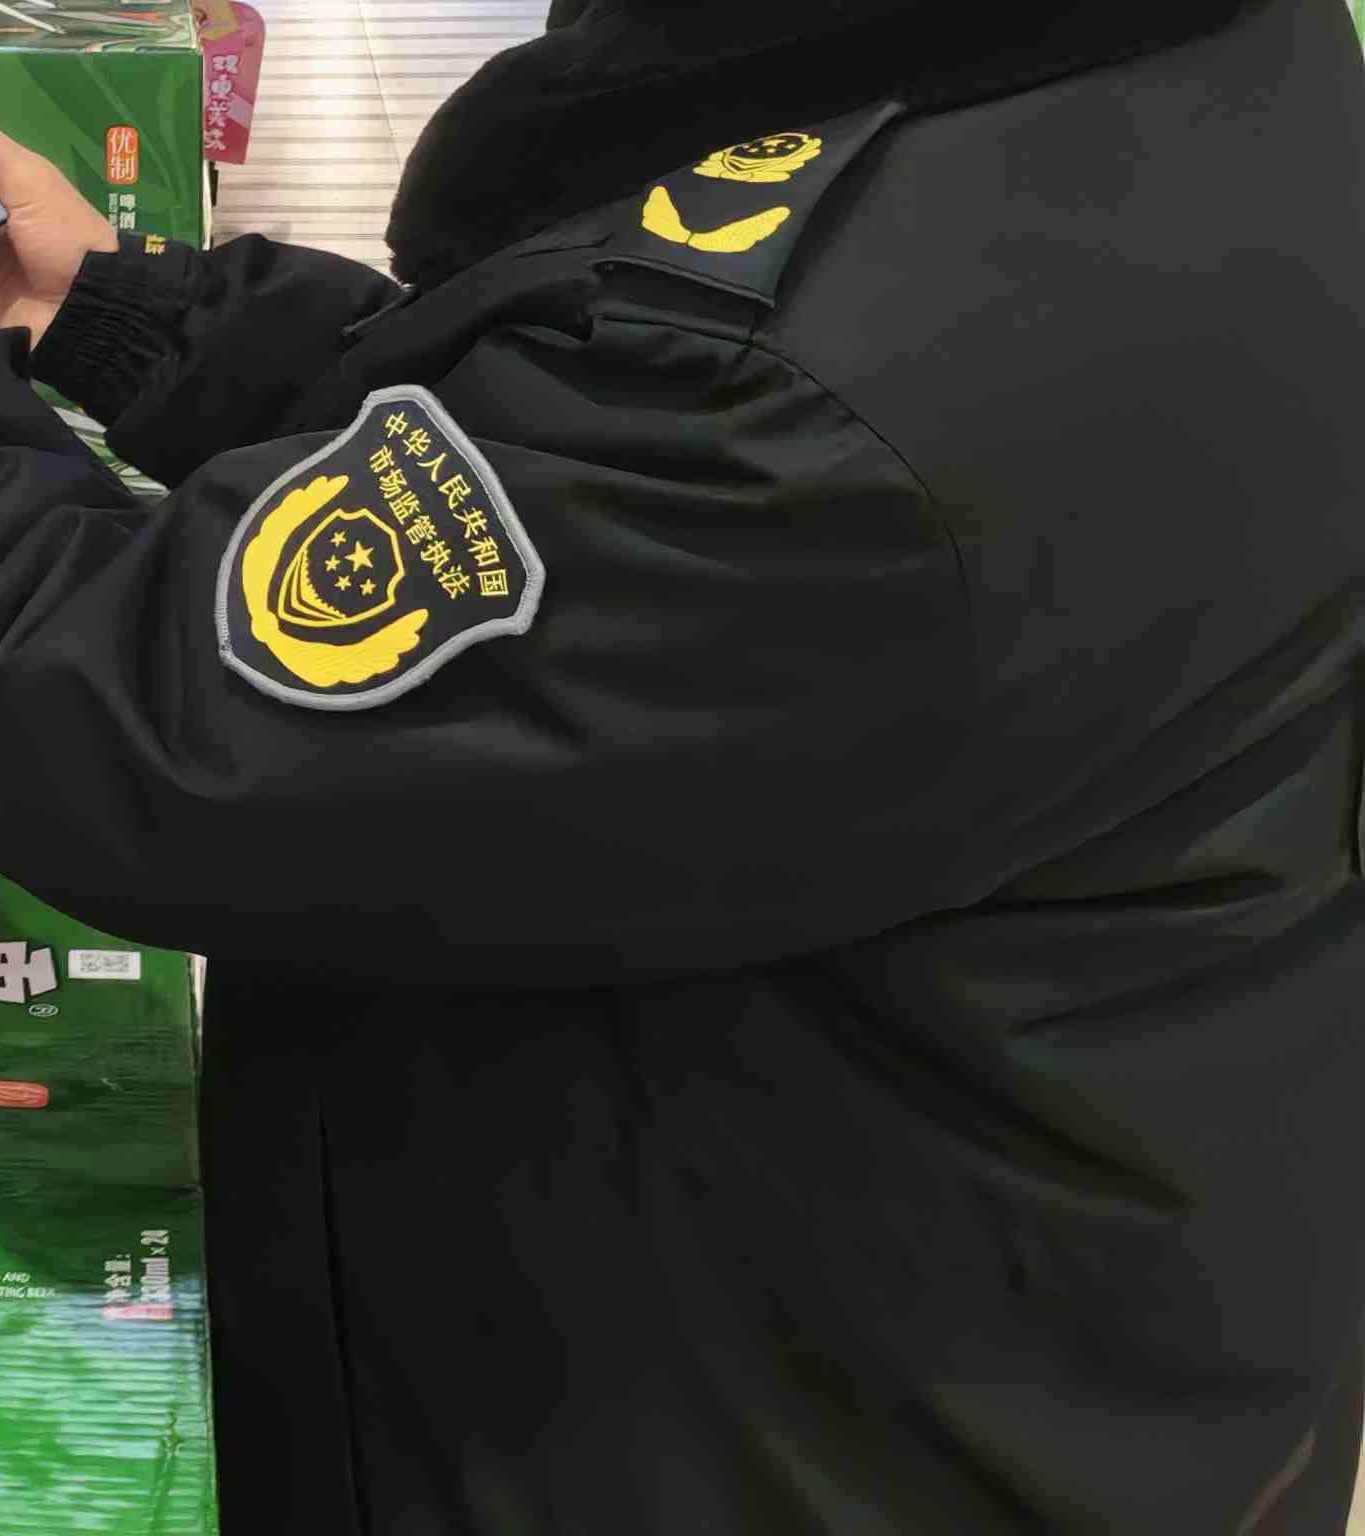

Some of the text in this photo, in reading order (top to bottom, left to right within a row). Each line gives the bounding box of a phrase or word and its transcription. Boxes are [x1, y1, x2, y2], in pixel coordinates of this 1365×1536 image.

[107, 128, 136, 181] 优制
[367, 444, 472, 603] 市场监管执法
[382, 410, 511, 600] 中华人民共和国
[2, 1271, 31, 1283] AND
